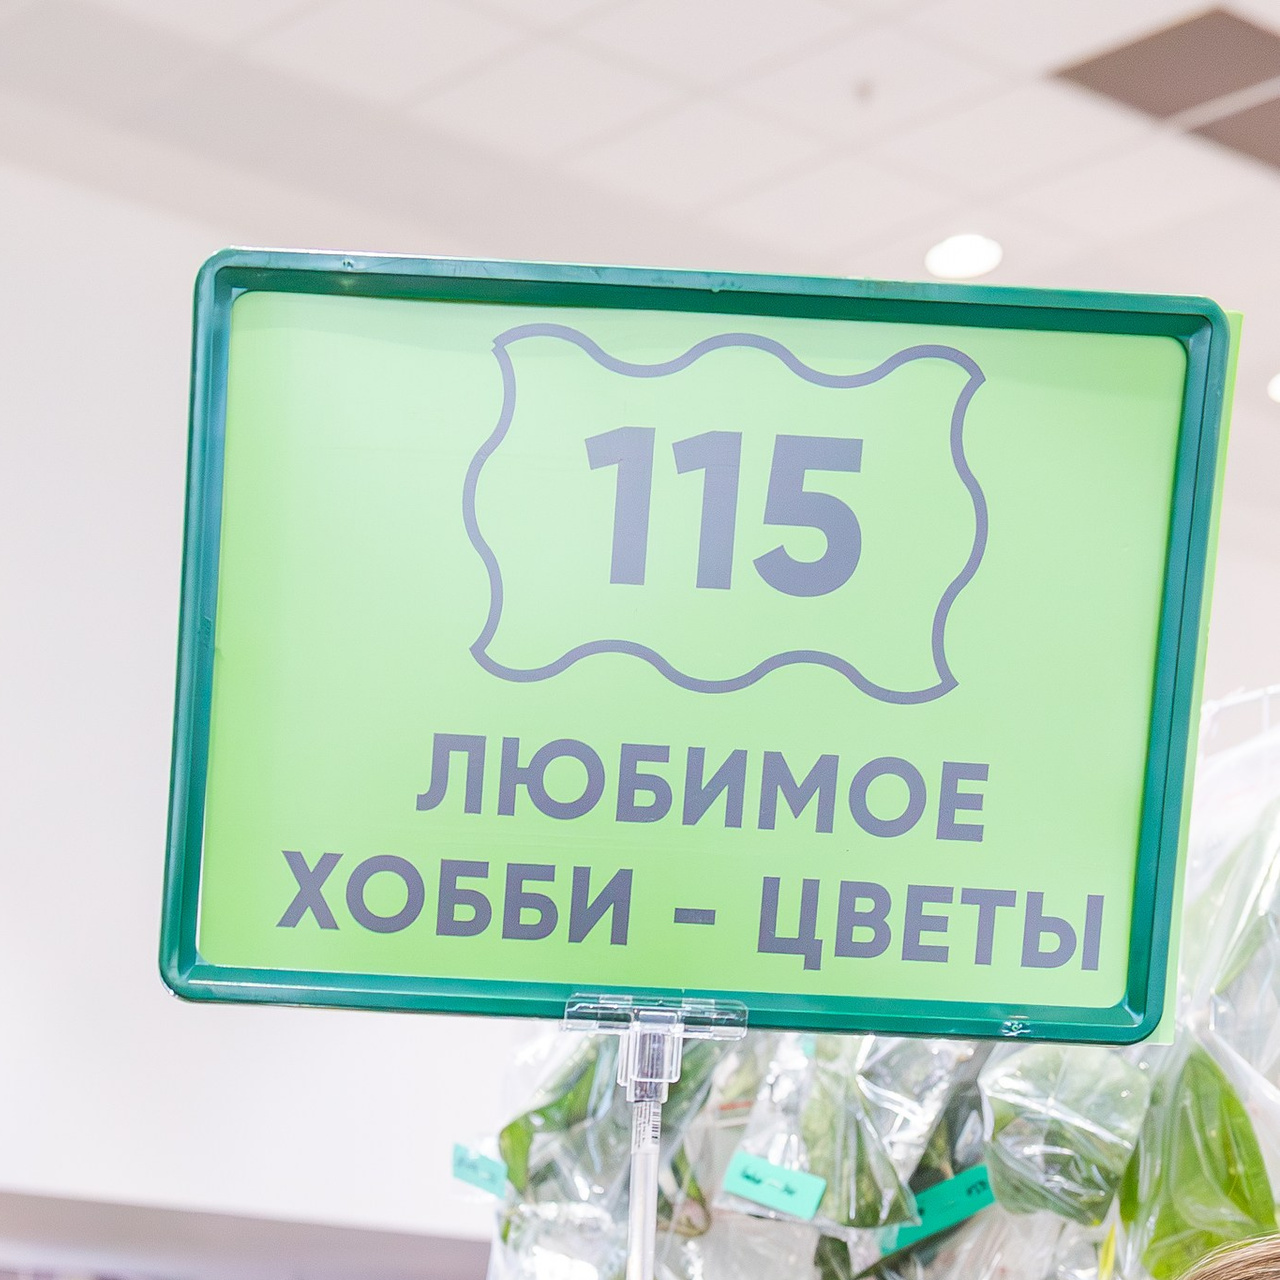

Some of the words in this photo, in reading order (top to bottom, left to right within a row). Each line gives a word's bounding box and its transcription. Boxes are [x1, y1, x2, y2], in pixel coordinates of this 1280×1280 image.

[587, 427, 863, 597] 115
[416, 733, 989, 842] ЛЮБИМОЕ
[277, 851, 632, 945] ХОББИ
[674, 908, 715, 924] -
[758, 877, 1104, 970] ЦВЕТЫ
